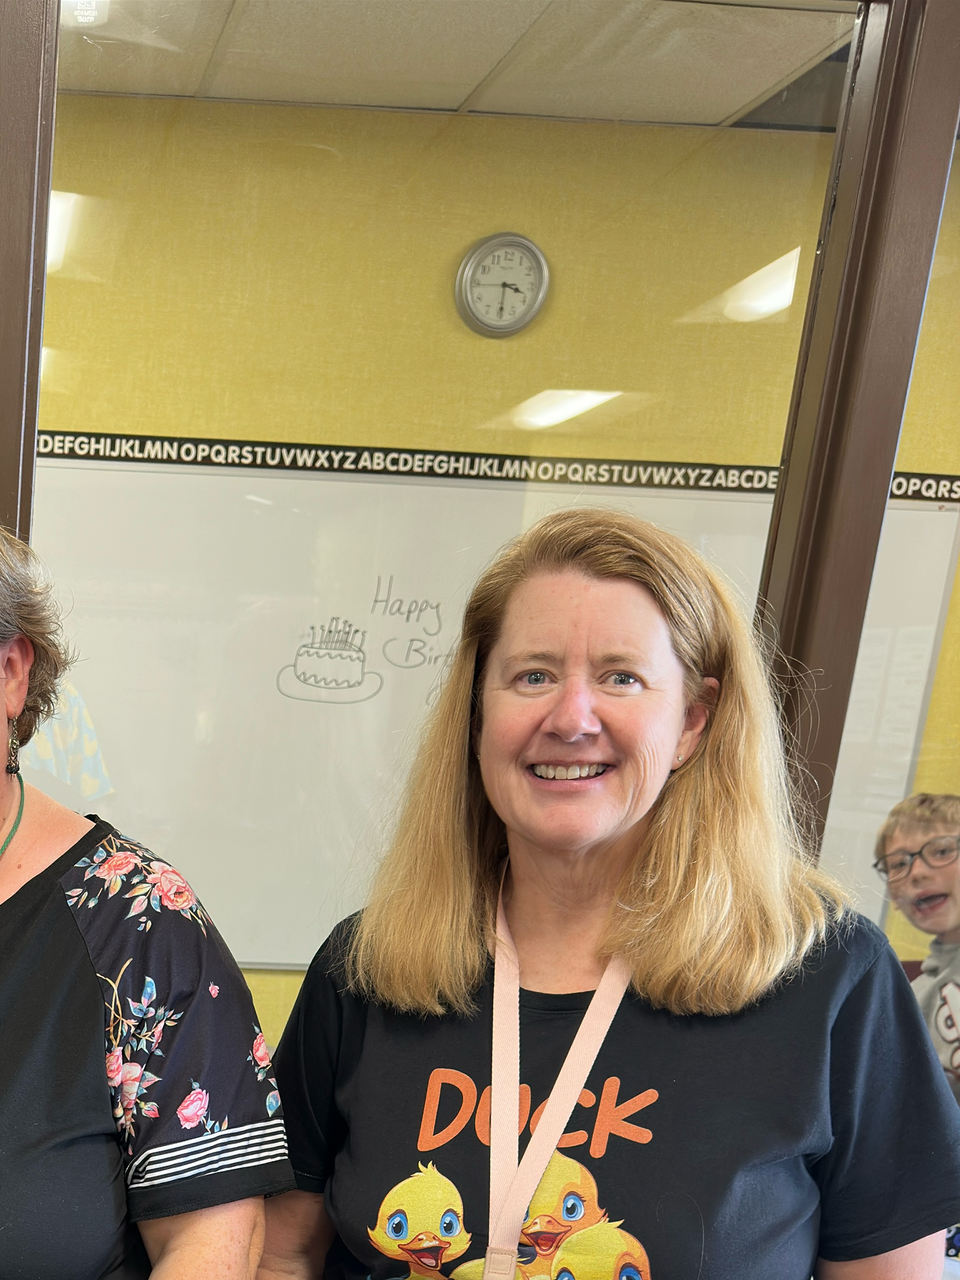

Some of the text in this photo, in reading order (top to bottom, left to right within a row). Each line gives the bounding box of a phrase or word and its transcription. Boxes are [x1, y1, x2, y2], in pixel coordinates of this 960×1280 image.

[491, 254, 500, 265] 11
[504, 251, 515, 262] 12
[481, 265, 491, 275] 10
[371, 575, 442, 636] Happy
[416, 1068, 659, 1159] DUCK
